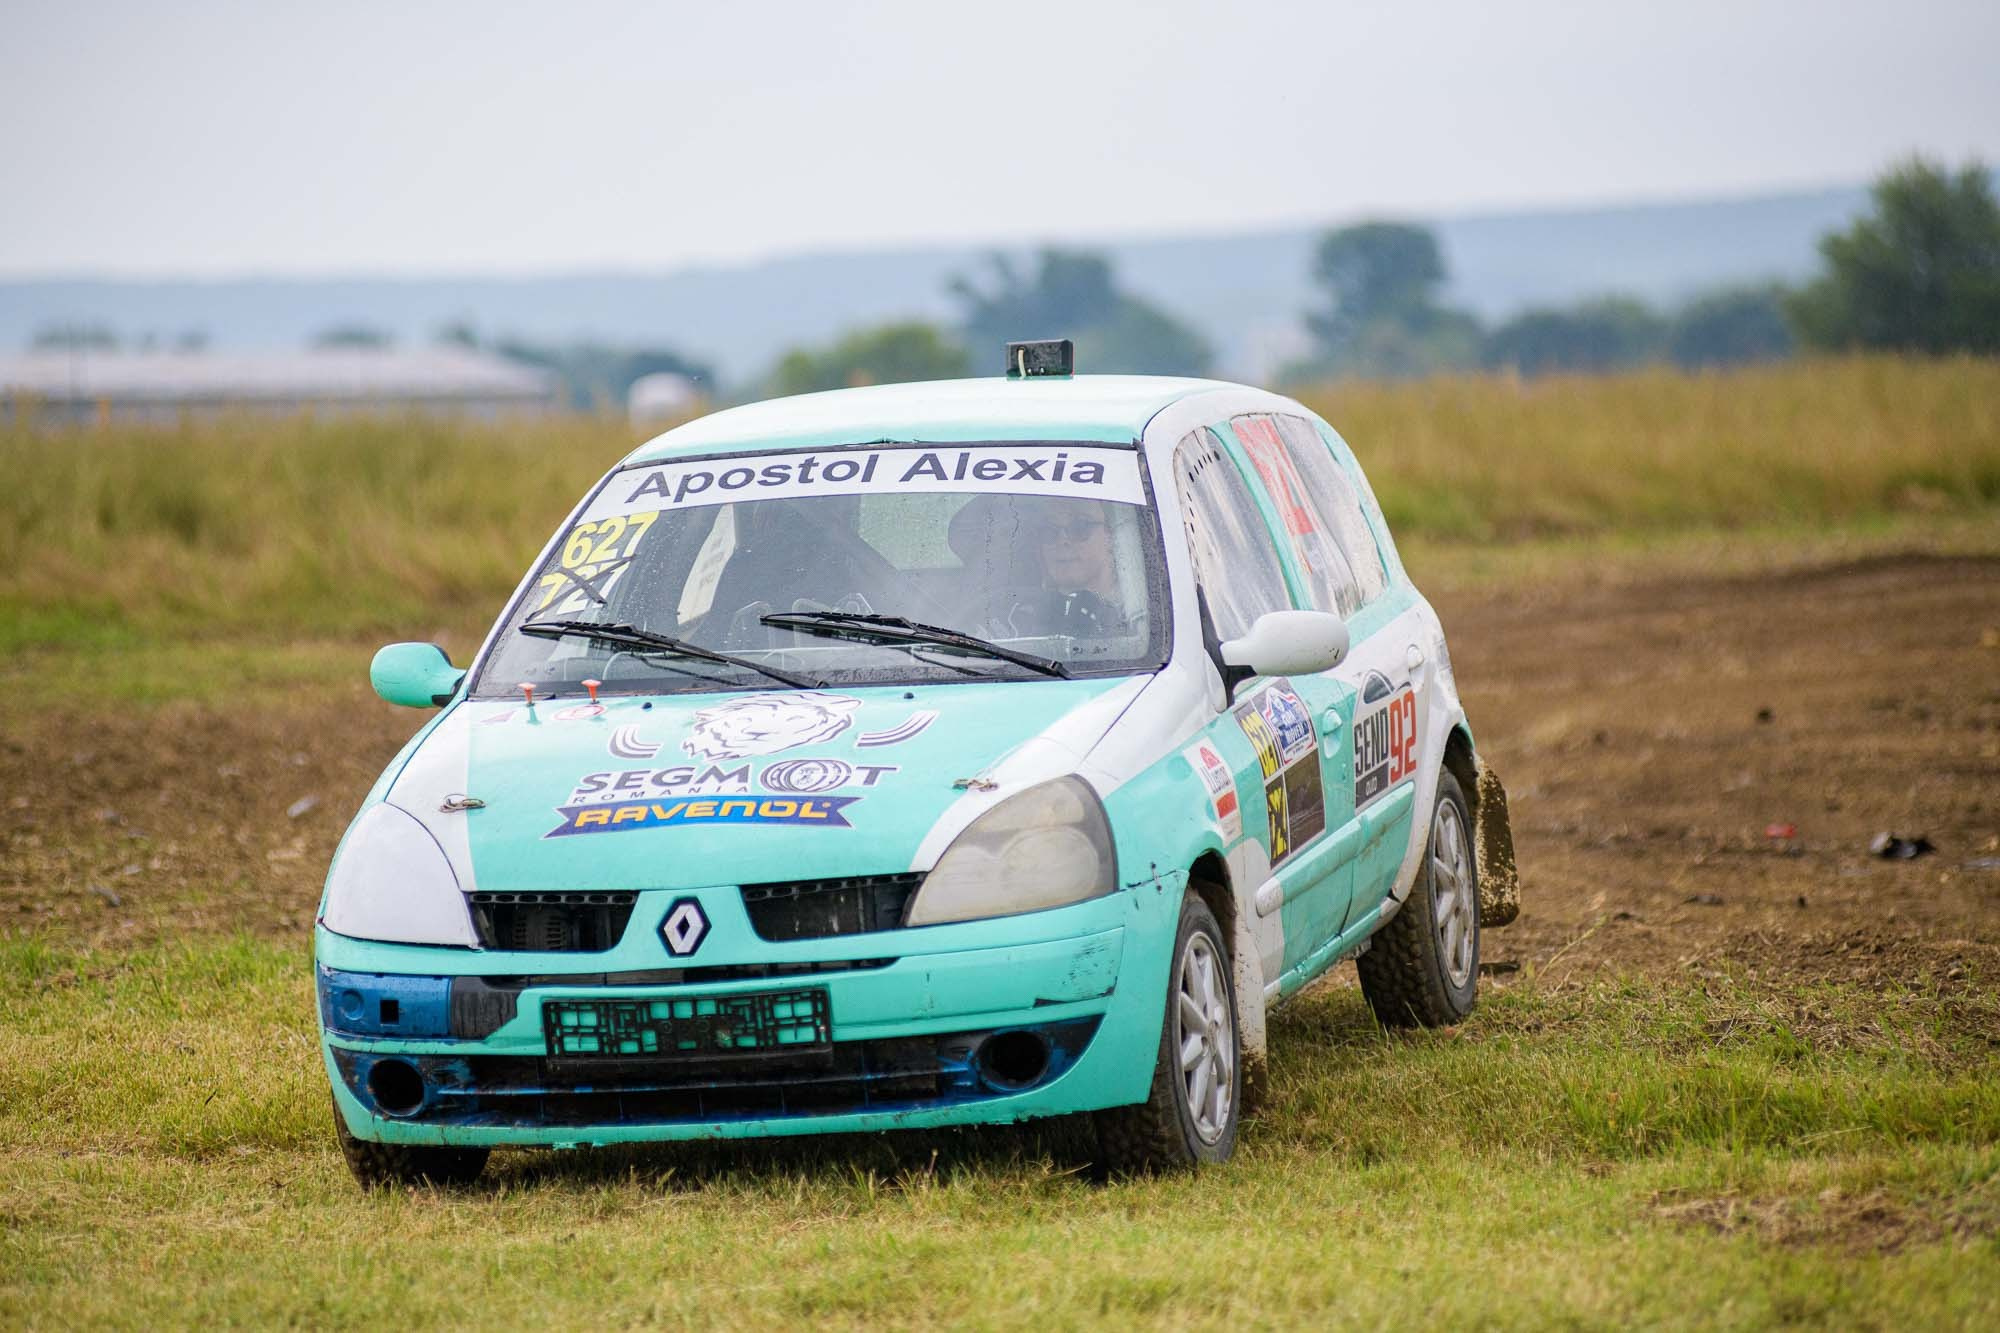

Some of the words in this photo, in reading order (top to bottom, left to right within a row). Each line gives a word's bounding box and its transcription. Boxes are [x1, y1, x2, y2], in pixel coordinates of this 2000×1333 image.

[624, 453, 879, 504] Apostol
[900, 451, 1106, 484] Alexia
[562, 510, 660, 569] 627
[1354, 707, 1389, 778] SEND
[1389, 690, 1417, 784] 92
[573, 786, 749, 804] ROMANIA
[574, 800, 830, 828] RAVENOL
